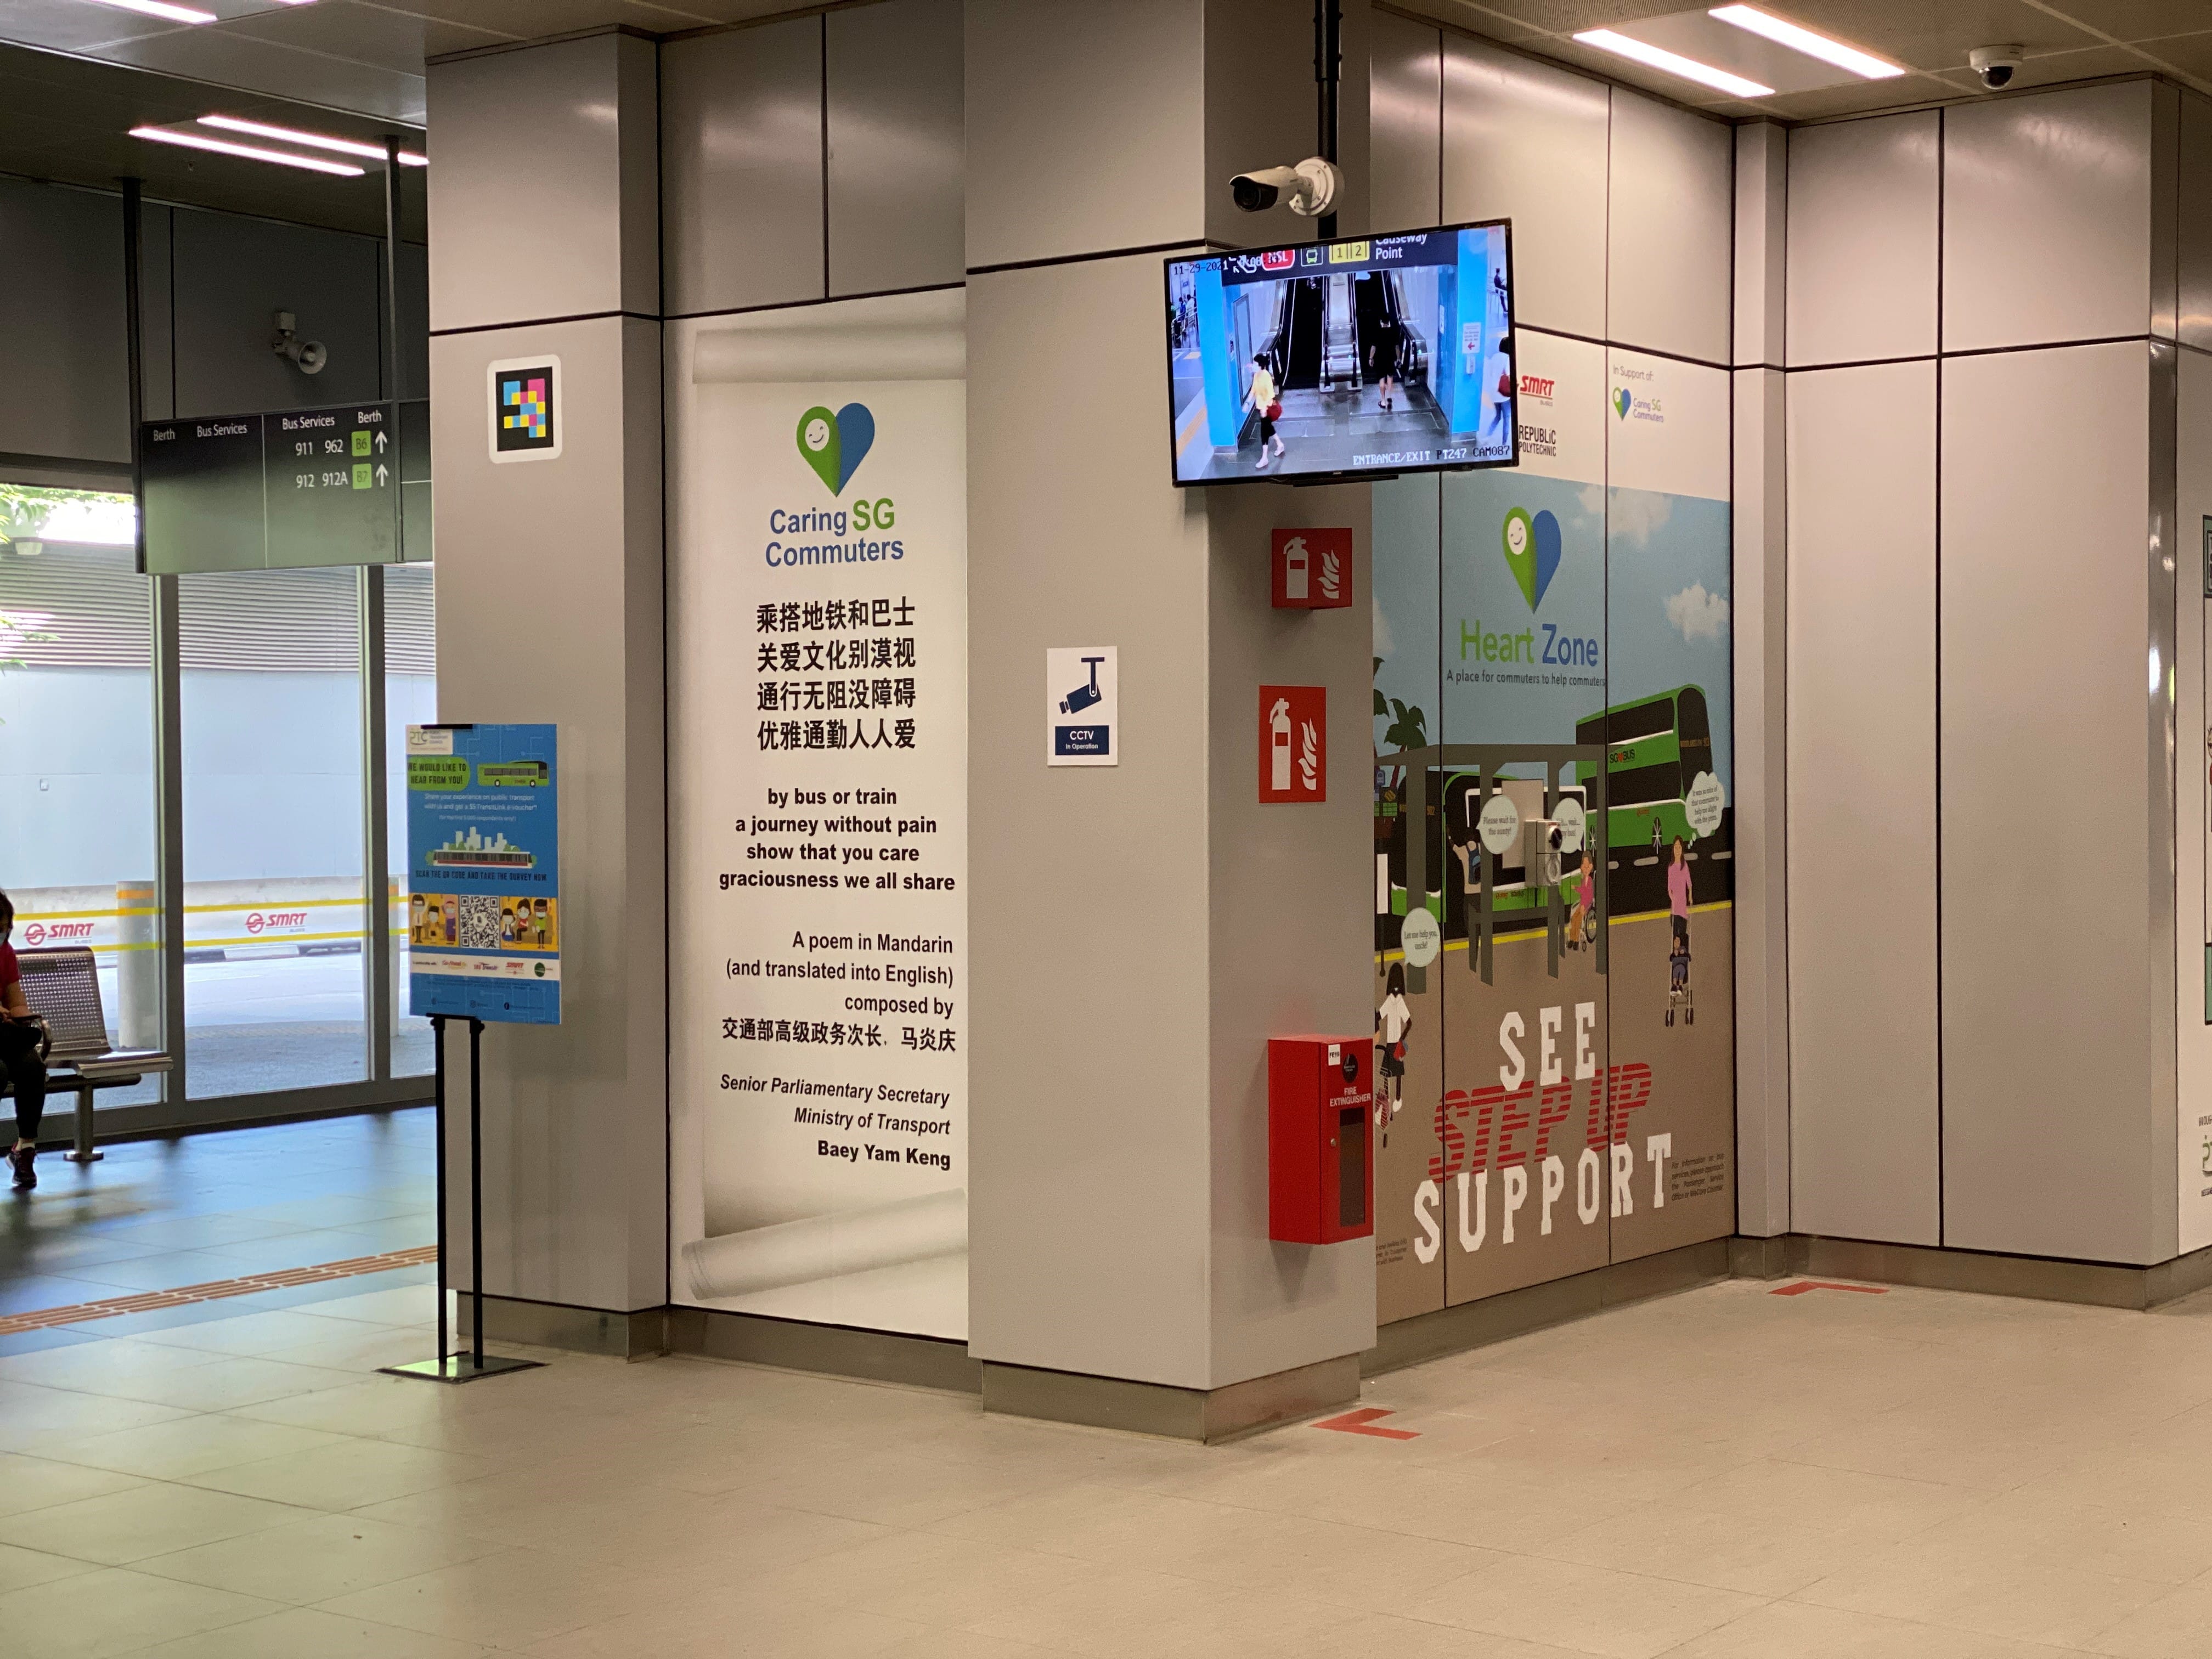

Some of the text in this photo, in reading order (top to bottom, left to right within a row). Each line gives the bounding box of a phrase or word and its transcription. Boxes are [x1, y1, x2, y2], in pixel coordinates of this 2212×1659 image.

[1338, 247, 1342, 258] 1
[1356, 245, 1362, 256] 2
[1375, 247, 1403, 259] Point
[1173, 261, 1228, 275] 11-29-2021
[1613, 364, 1619, 374] In
[1620, 365, 1645, 380] Support
[1520, 375, 1555, 396] SMRT
[1633, 398, 1661, 411] Caring SG
[283, 409, 382, 430] Bus Services Berth
[1633, 409, 1664, 422] Commuters
[153, 423, 247, 441] Berth Bus Services
[296, 438, 367, 456] 911 962 B6
[1353, 451, 1430, 465] ENTRANCE/EXIT
[1436, 448, 1467, 460] PT247
[1519, 441, 1556, 456] POLYTECHNIC
[296, 471, 368, 488] 912 912A B7
[770, 498, 895, 537] Caring SG
[766, 537, 904, 567] Commuters
[757, 596, 915, 633] 乘搭地铁和巴士
[1461, 619, 1598, 667] Heart Zone
[757, 637, 916, 673] 关爱文化别漠视
[1447, 669, 1606, 687] A place for commuters to help commuters
[757, 678, 916, 712] 通行无阻没障碍
[757, 718, 916, 751] 优雅通勤人人爱
[1070, 730, 1094, 740] CCTV
[419, 763, 440, 772] WOULD
[442, 763, 456, 772] LIKE
[459, 763, 466, 772] TO
[410, 775, 462, 784] HEAR FROM YOU!
[768, 788, 897, 809] by bus or train
[736, 815, 936, 837] a journey without pain
[747, 843, 919, 865] show that you care
[497, 872, 507, 881] THE
[509, 872, 532, 881] SURVEY
[534, 873, 548, 882] NOW
[719, 870, 955, 890] graciousness we all share
[266, 913, 307, 927] SMRT
[48, 923, 94, 938] SMRT
[792, 931, 953, 953] A poem in Mandarin
[726, 958, 953, 989] (and translated into English)
[845, 996, 953, 1019] composed by
[1500, 1002, 1595, 1091] SEE
[720, 1074, 950, 1109] Senior Parliamentary Secretary
[1330, 1093, 1371, 1107] EXTINGUISHER
[1344, 1087, 1357, 1096] FIRE
[794, 1107, 951, 1137] Ministry of Transport
[1429, 1063, 1652, 1183] STEP UP
[818, 1139, 950, 1171] Baey Yam Keng
[1414, 1132, 1672, 1264] SUPPORT
